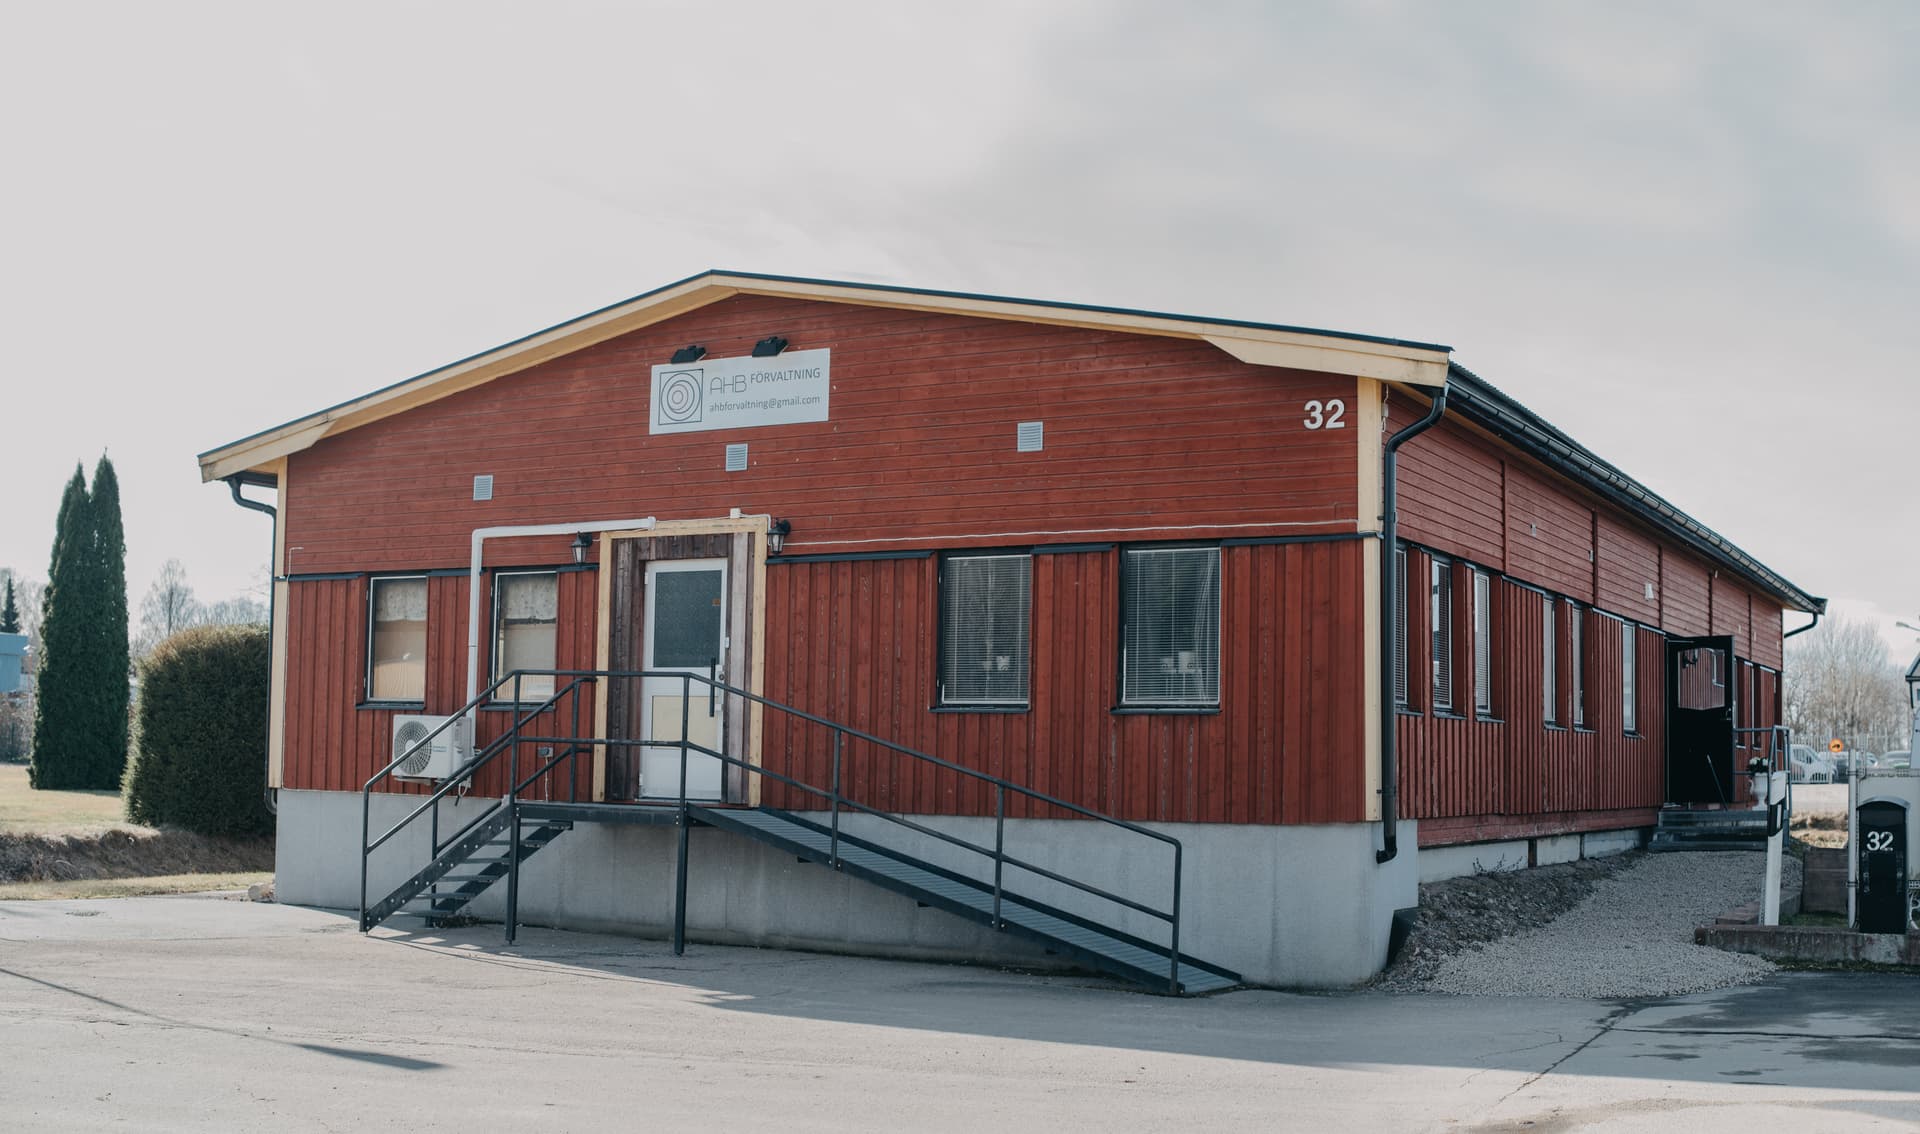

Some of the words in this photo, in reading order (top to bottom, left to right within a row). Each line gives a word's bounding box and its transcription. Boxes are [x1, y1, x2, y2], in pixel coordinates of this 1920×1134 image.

[709, 375, 748, 394] AHB
[750, 367, 821, 384] FÖRVALTNING
[709, 396, 821, 412] ahbforvaltning@gmail.com
[1303, 399, 1345, 430] 32
[1866, 831, 1894, 851] 32
